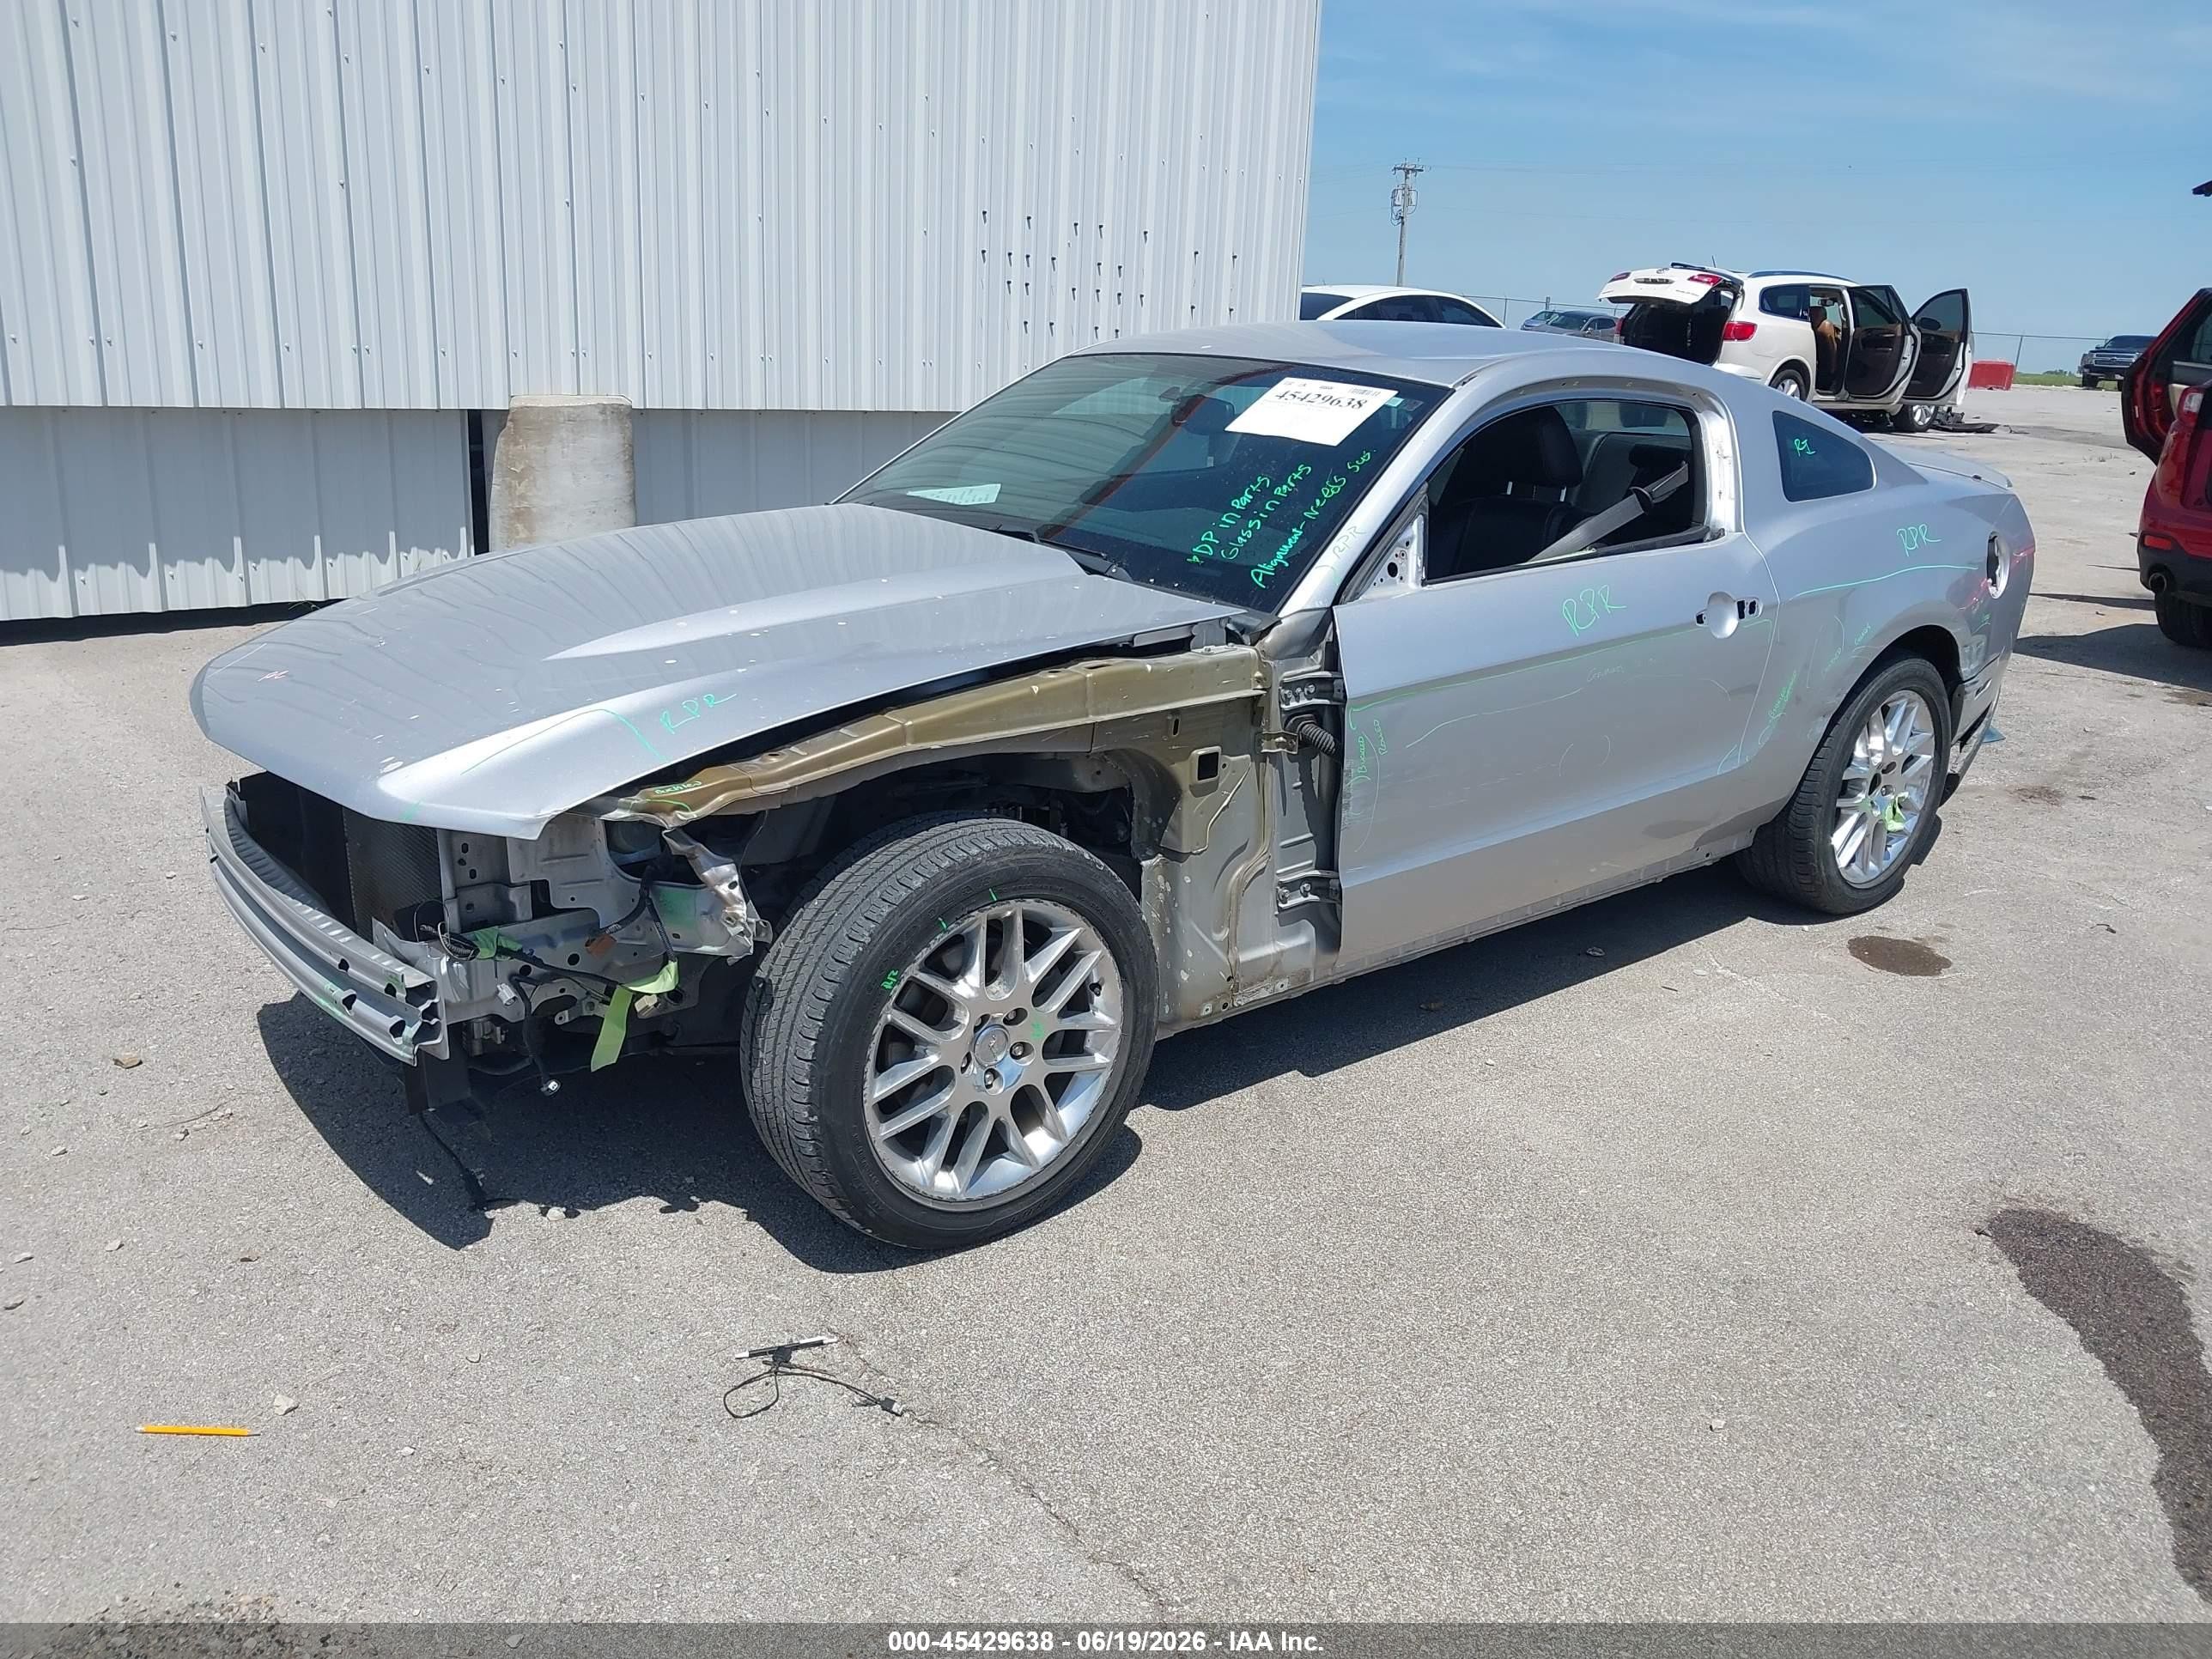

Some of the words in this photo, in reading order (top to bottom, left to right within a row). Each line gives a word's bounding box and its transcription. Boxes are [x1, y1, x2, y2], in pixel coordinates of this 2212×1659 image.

[1275, 390, 1368, 410] 45429638
[1273, 464, 1312, 497] Parts
[1193, 531, 1219, 556] DP
[1231, 476, 1271, 510] Parts
